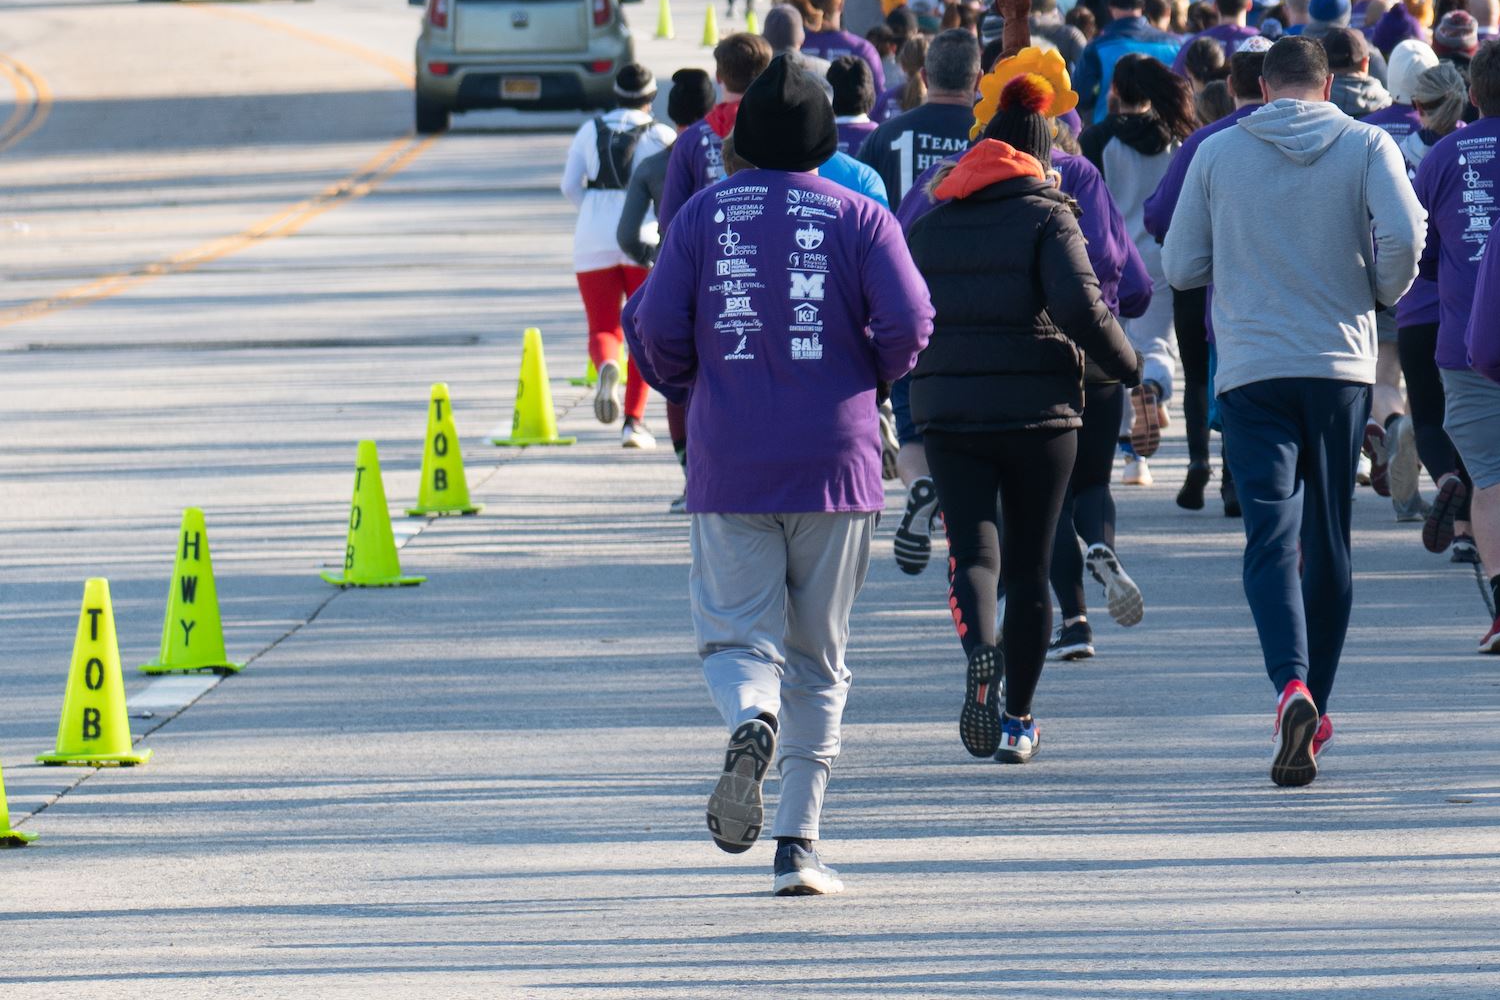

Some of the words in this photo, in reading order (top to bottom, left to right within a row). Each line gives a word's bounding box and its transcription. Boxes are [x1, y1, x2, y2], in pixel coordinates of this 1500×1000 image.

[918, 133, 969, 151] TEAM
[1457, 137, 1497, 146] FOLEYGRIFFIN
[890, 130, 914, 200] 1
[716, 186, 768, 198] FOLEYGRIFFIN
[801, 191, 841, 206] JOSEPH
[727, 215, 754, 223] SOCIETY
[804, 253, 827, 261] PARK
[790, 272, 825, 298] M
[726, 297, 751, 310] EXIT
[791, 335, 823, 350] SAL
[434, 399, 448, 491] TOB
[345, 467, 366, 570] TOB
[181, 531, 200, 646] HWY
[82, 608, 104, 741] TOB
